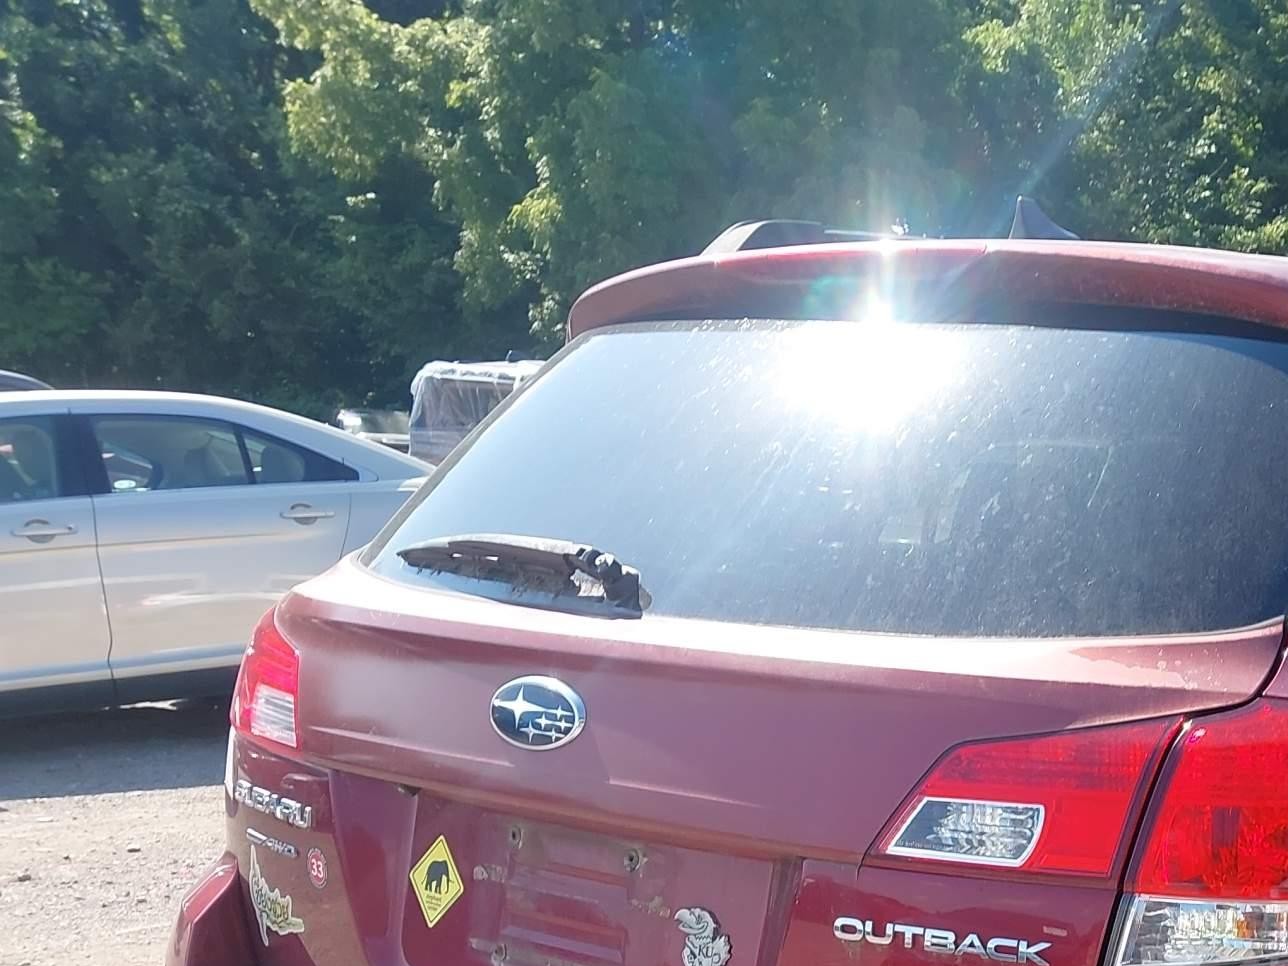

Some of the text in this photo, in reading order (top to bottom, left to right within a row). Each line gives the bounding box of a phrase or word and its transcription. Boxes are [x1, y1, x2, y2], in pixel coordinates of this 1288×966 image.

[235, 779, 312, 829] SUBARU
[310, 858, 324, 878] 33
[697, 943, 714, 959] KU
